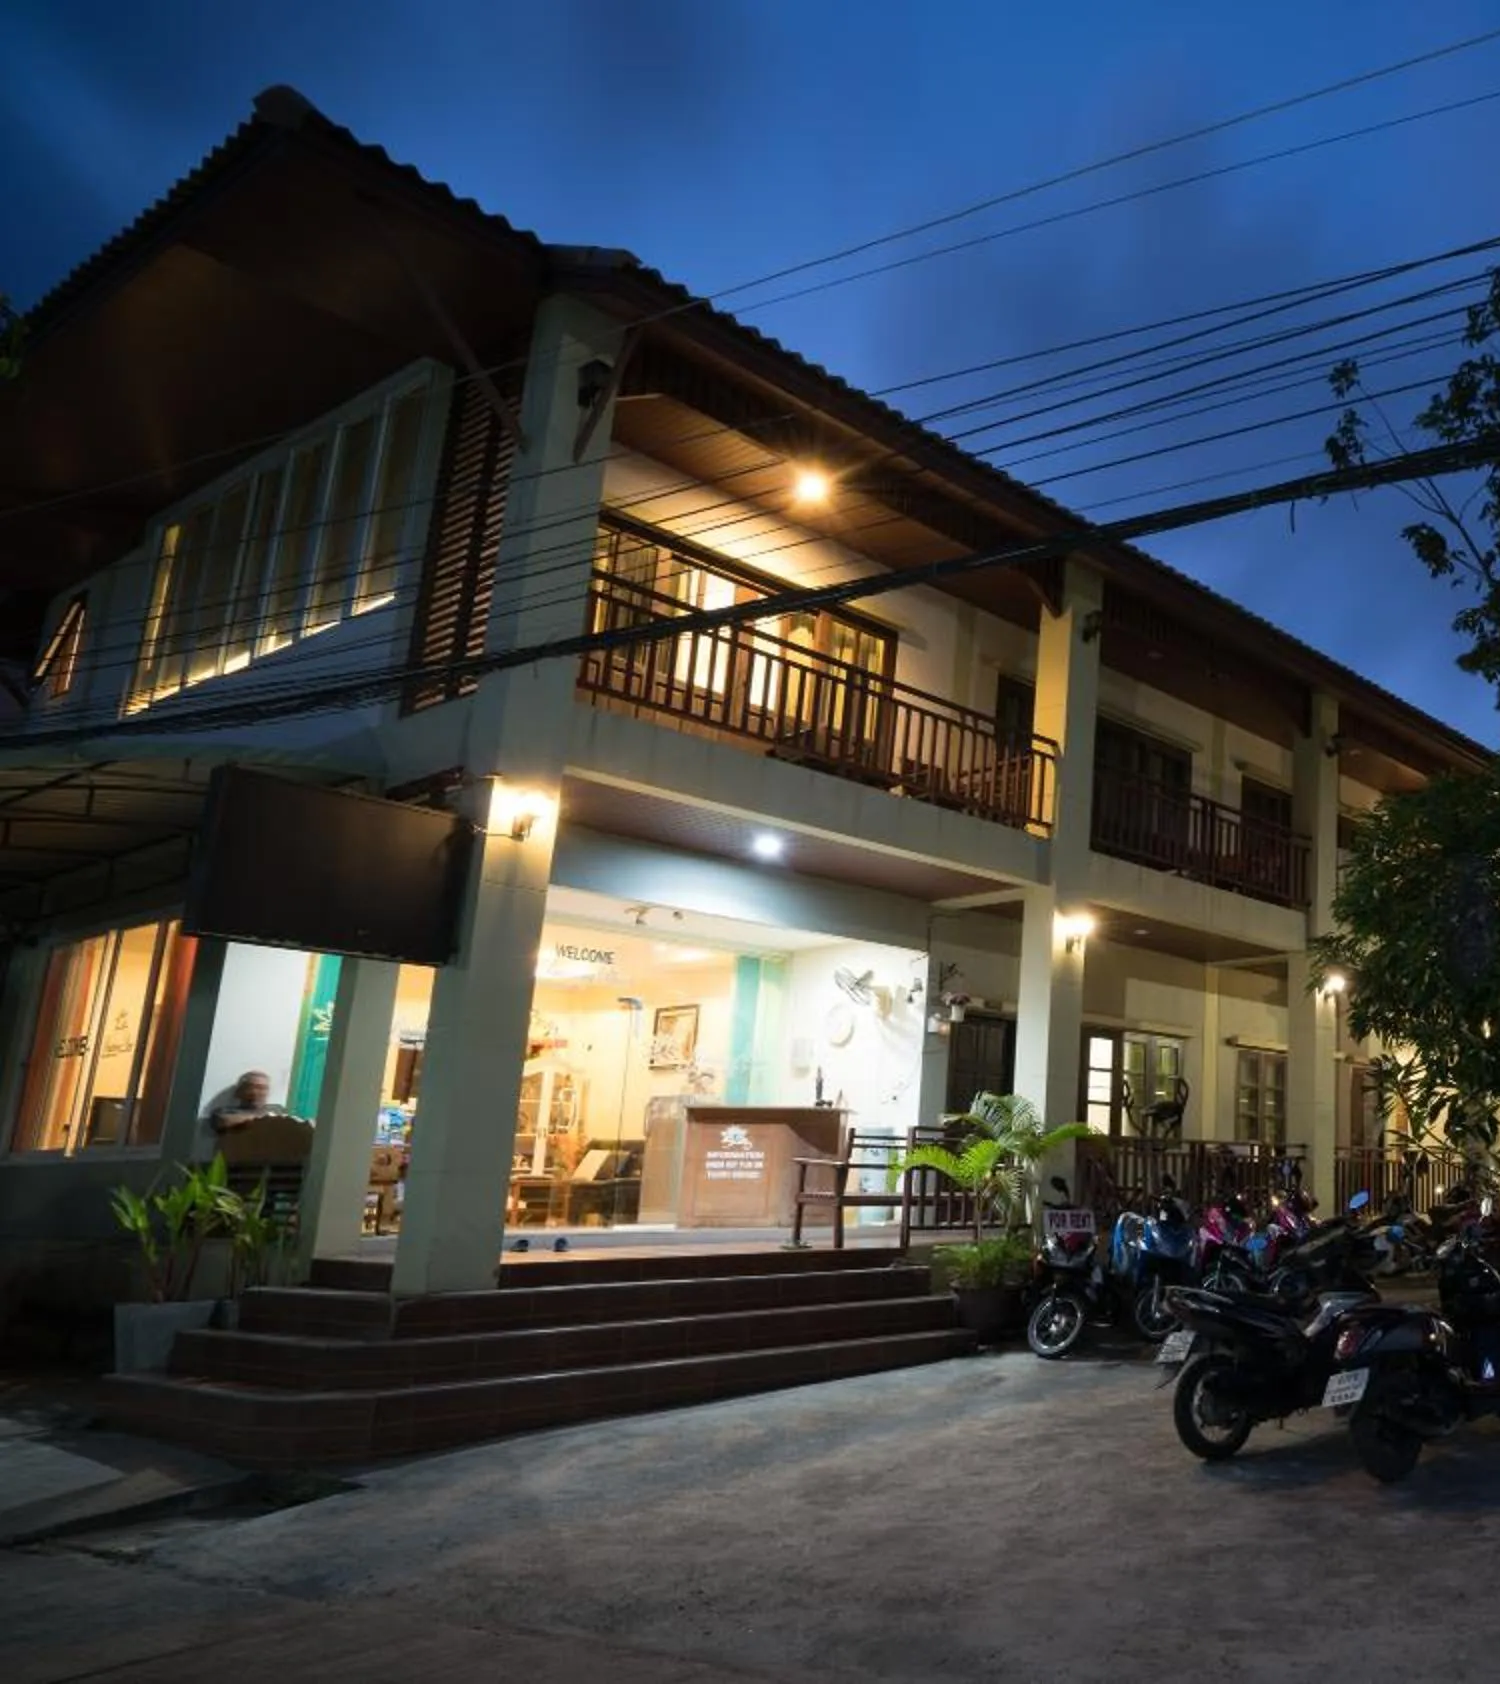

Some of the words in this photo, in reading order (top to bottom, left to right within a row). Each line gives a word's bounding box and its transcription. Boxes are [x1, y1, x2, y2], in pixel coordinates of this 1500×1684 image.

[555, 941, 616, 965] WELCOME
[1048, 1211, 1068, 1230] FOR
[1070, 1211, 1092, 1230] RENT
